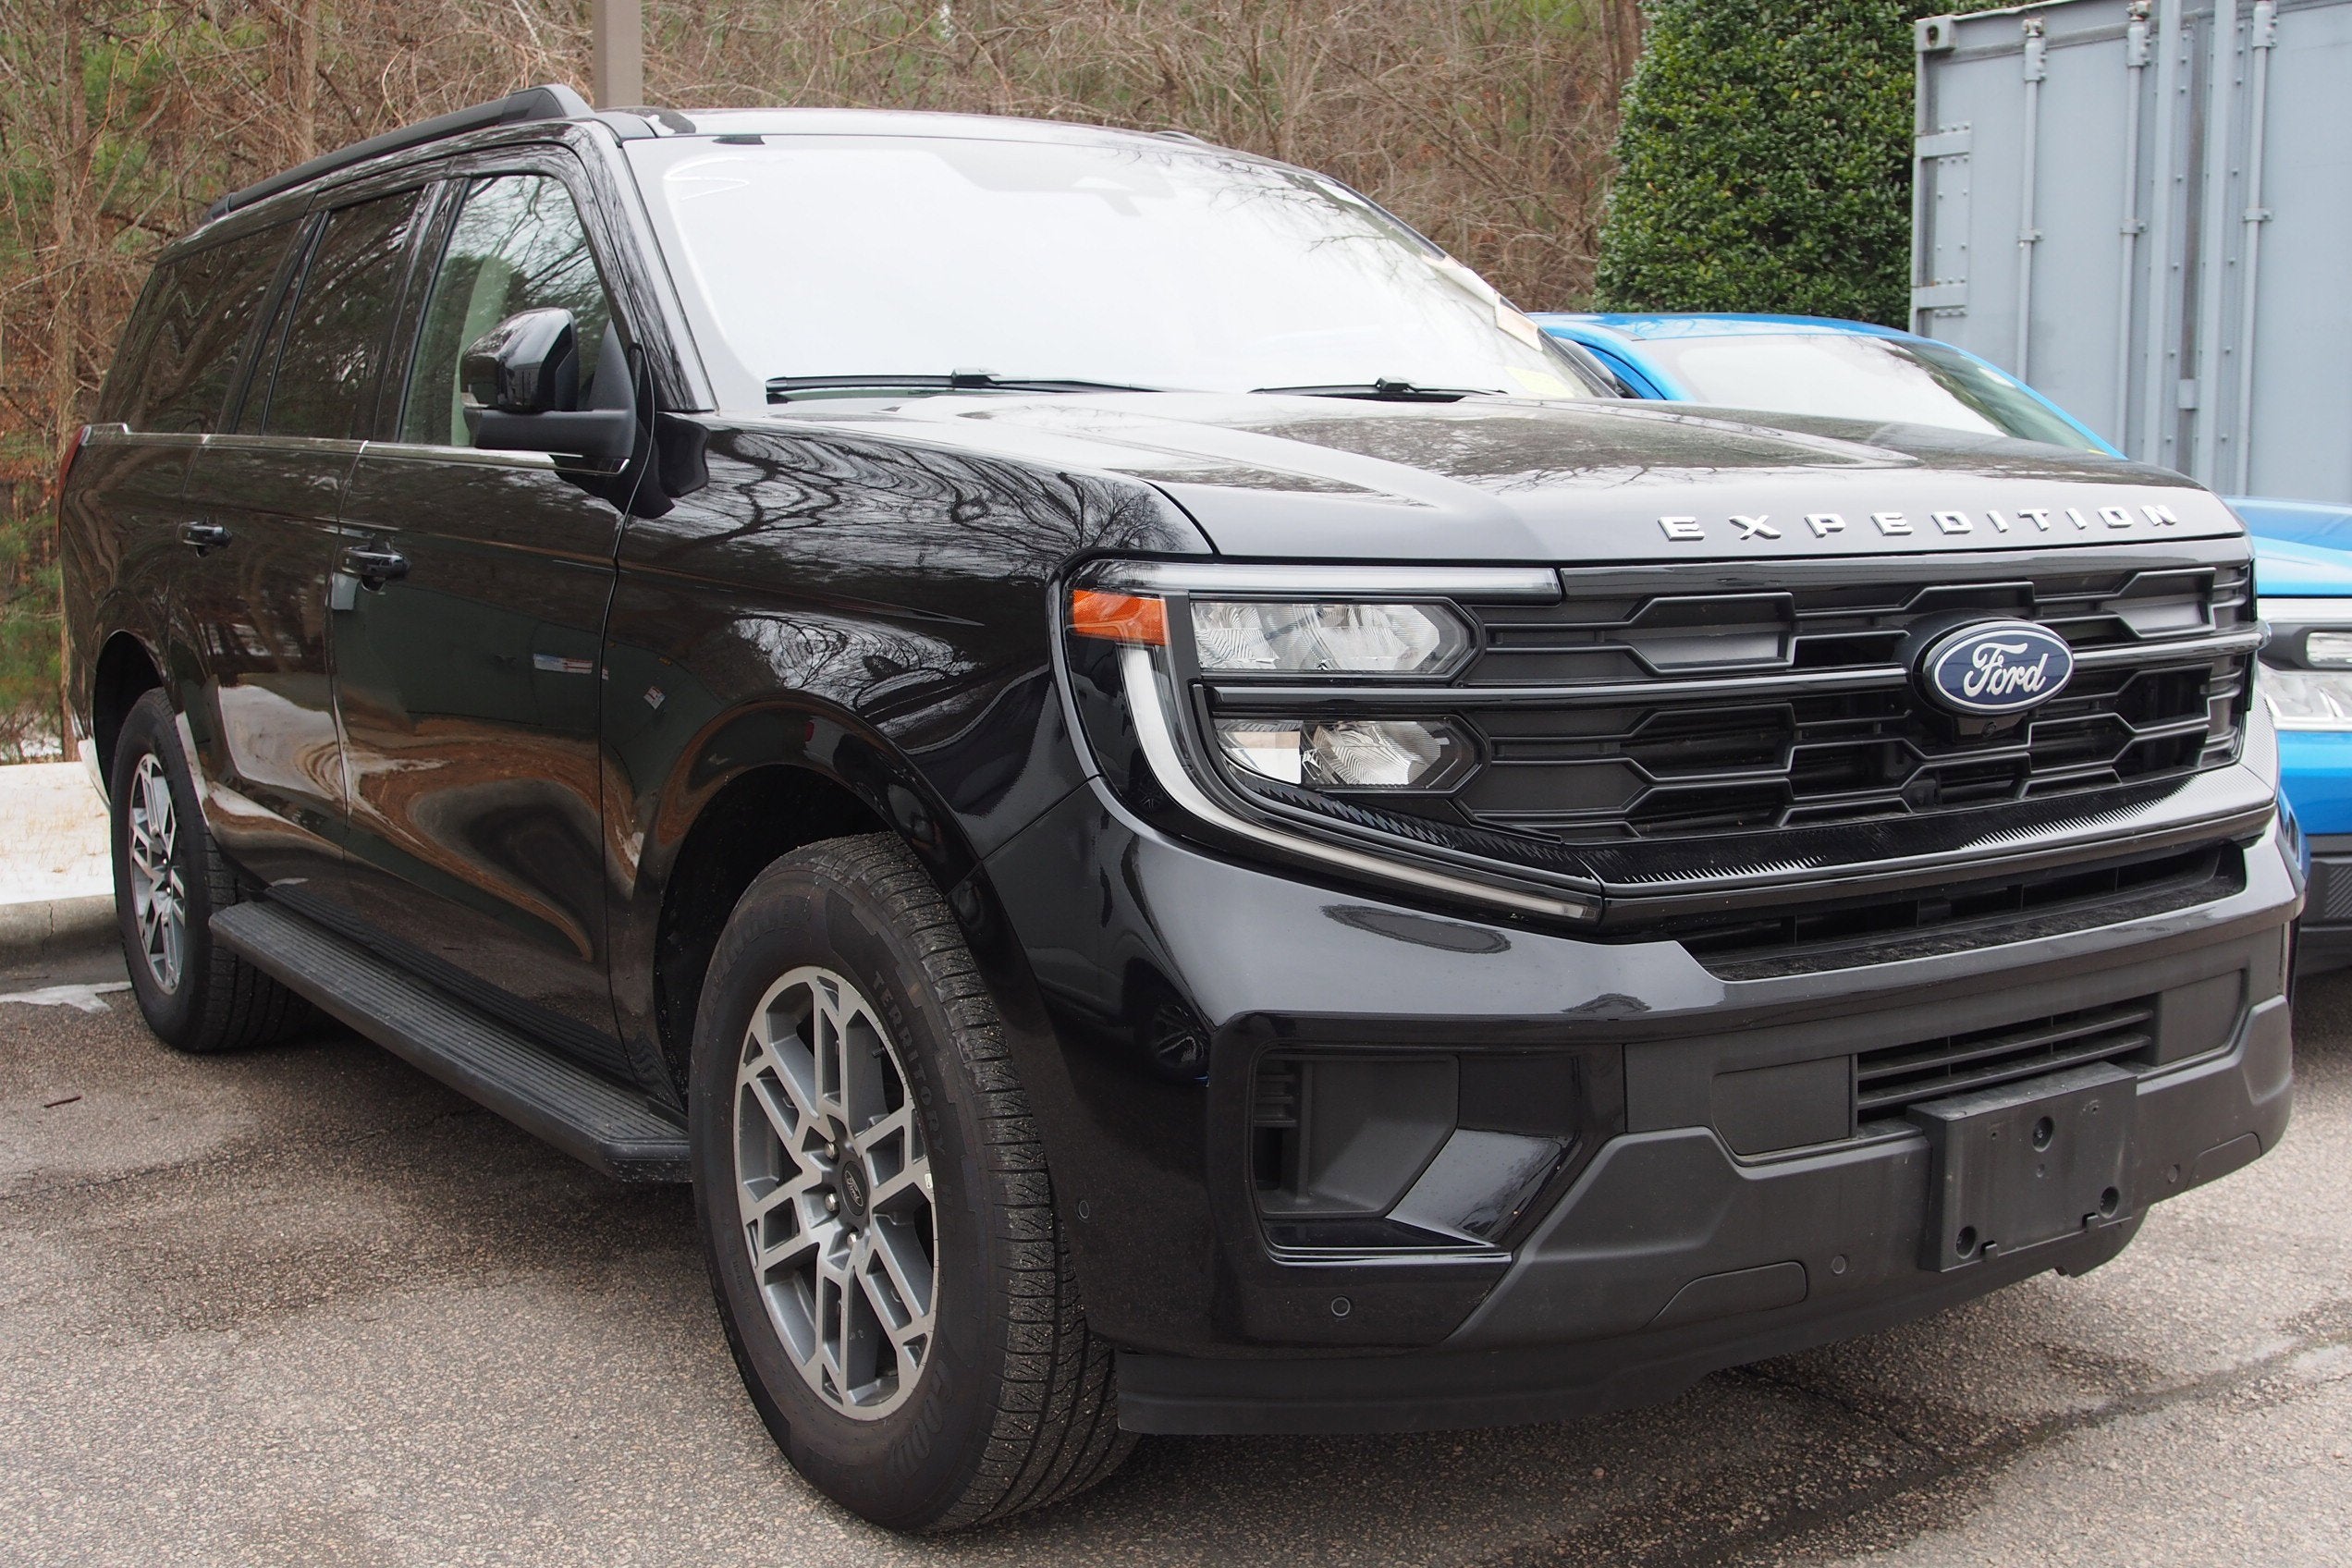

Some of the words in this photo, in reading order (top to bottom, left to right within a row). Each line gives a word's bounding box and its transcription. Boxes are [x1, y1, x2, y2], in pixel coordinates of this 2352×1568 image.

[1657, 505, 2178, 542] EXPEDITION
[1963, 643, 2049, 697] Ford
[873, 969, 948, 1156] TERRITORY
